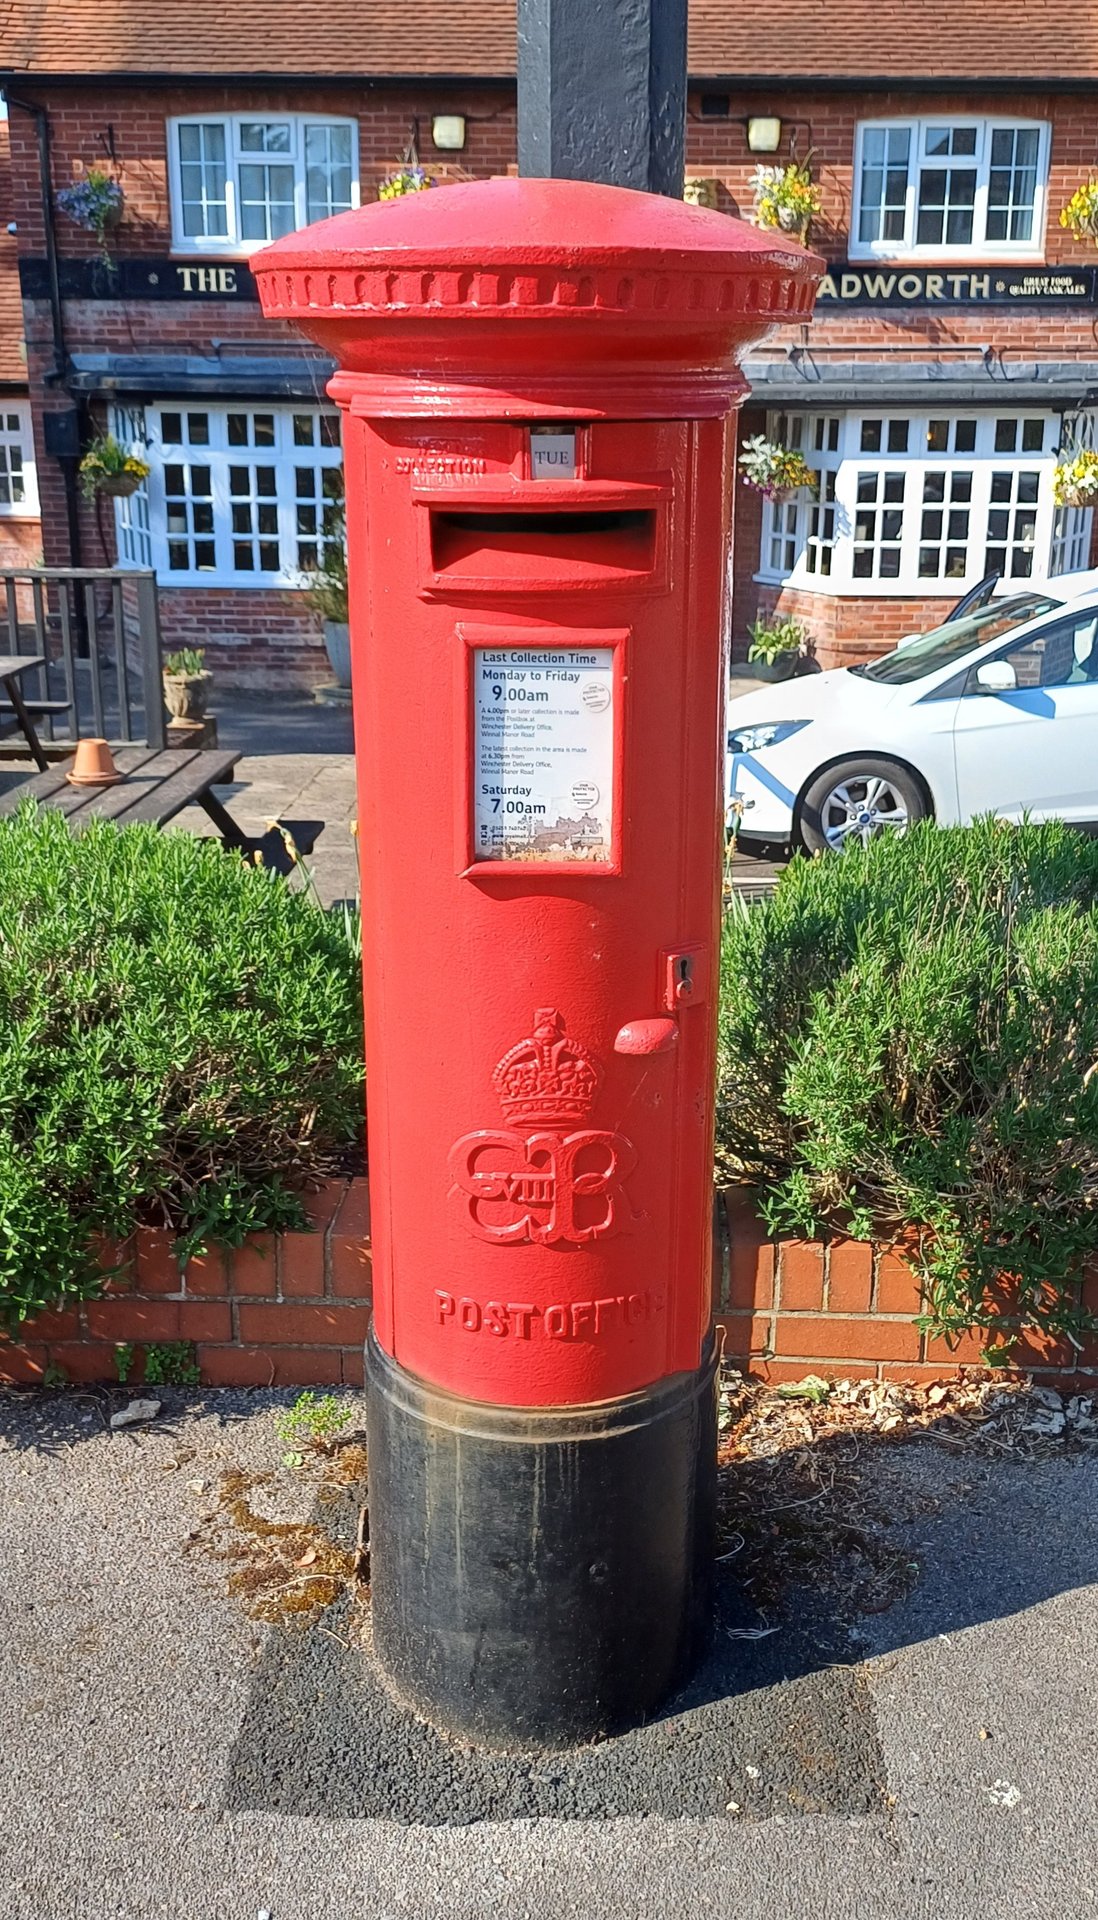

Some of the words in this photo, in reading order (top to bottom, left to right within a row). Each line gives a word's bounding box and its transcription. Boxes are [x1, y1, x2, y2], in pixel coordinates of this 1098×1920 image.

[176, 267, 238, 293] THE
[815, 273, 991, 300] ADWORTH
[1023, 276, 1049, 286] GREAT
[1050, 276, 1073, 286] FOOD
[1009, 284, 1042, 296] QUALITY
[1043, 284, 1064, 295] CASK
[1064, 284, 1086, 295] ALES
[534, 450, 569, 465] TUE
[482, 651, 507, 663] Last
[510, 652, 565, 664] Collection
[568, 653, 597, 664] Time
[482, 669, 526, 683] Monday
[530, 671, 542, 681] to
[545, 670, 580, 683] Friday
[492, 685, 549, 702] 9.00am
[487, 707, 509, 715] 4.00pm
[513, 723, 535, 731] Delivery
[481, 784, 532, 797] Saturday
[490, 799, 546, 814] 7.00am
[434, 1287, 543, 1341] POST
